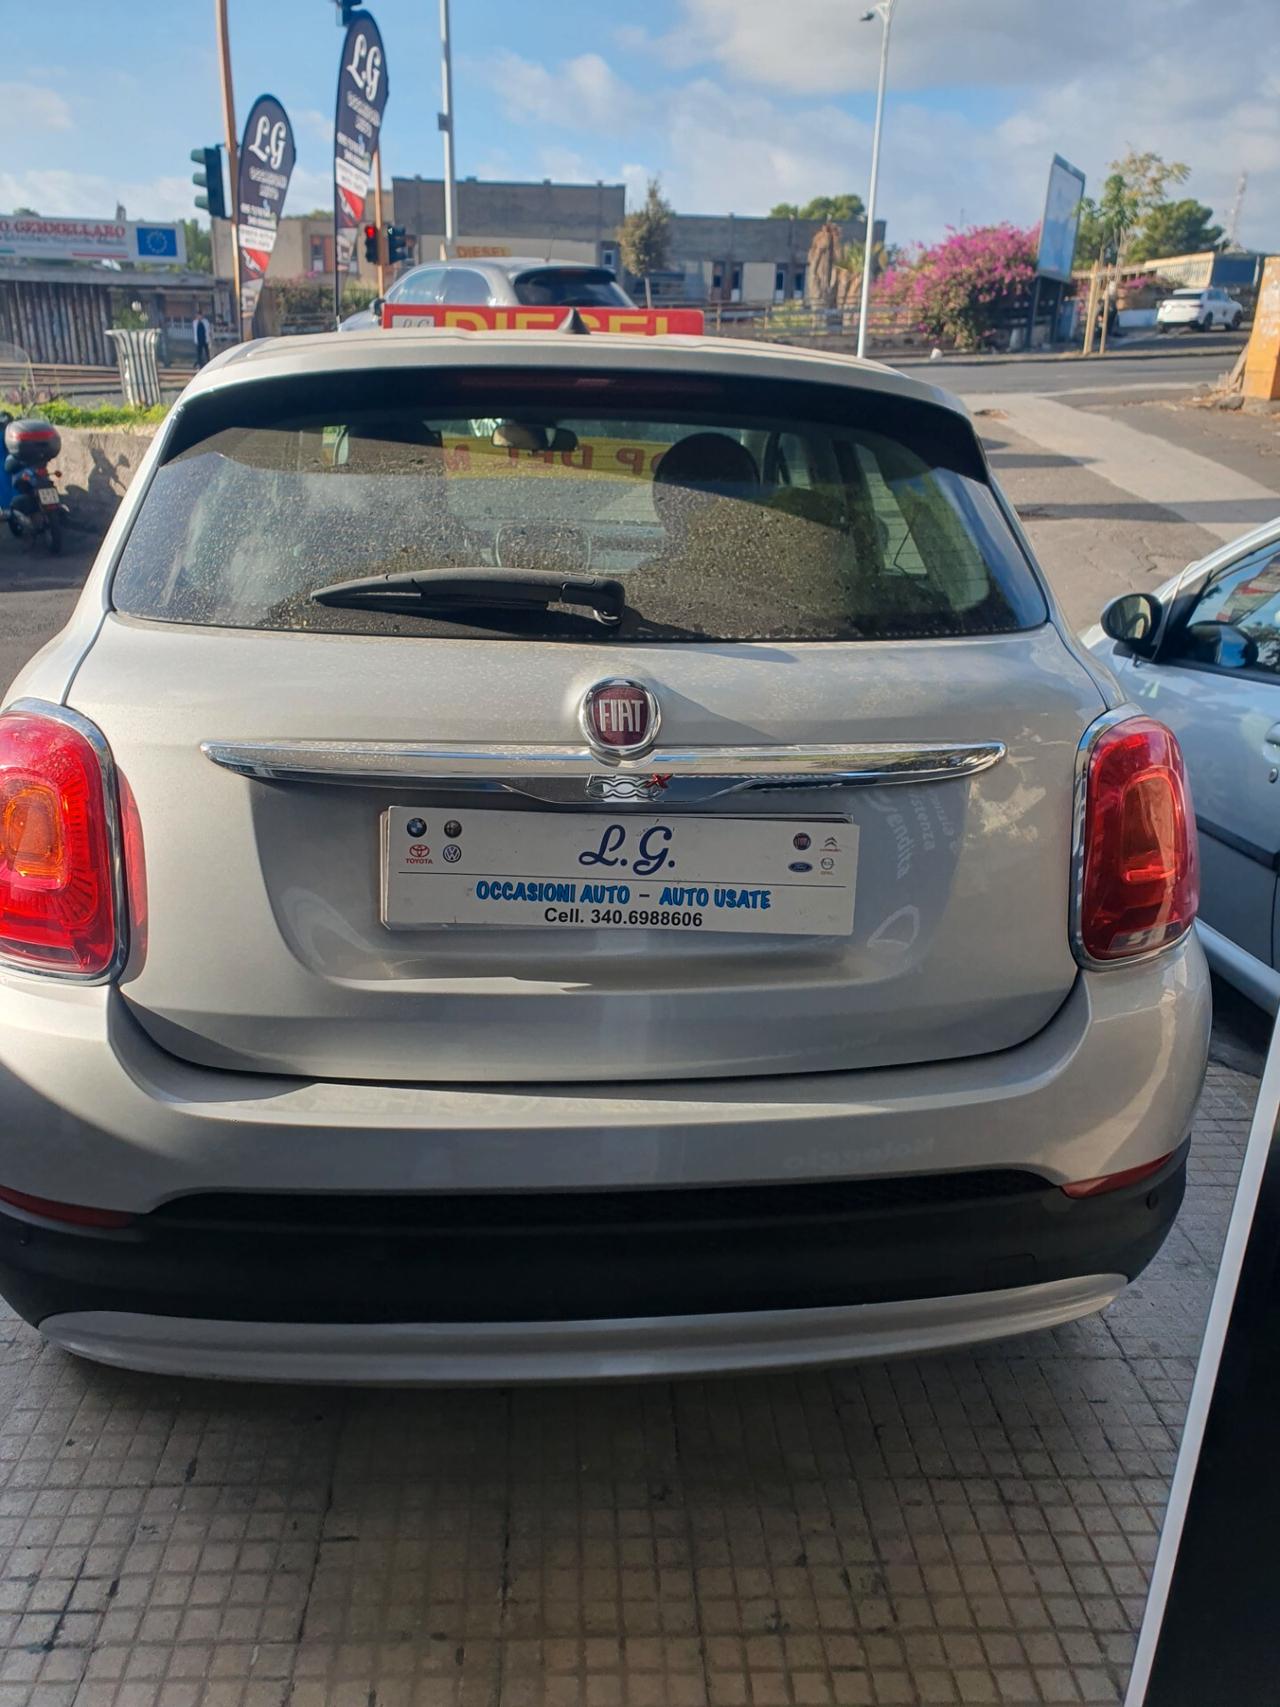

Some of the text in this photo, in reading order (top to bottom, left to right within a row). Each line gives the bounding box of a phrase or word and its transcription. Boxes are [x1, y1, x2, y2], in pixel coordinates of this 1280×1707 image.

[598, 699, 645, 733] FIAT
[476, 880, 576, 902] OCCASIONI
[580, 882, 630, 905] AUTO
[659, 887, 709, 908] AUTO
[713, 888, 772, 910] USATE
[544, 906, 703, 928] Cell. 340.6988606
